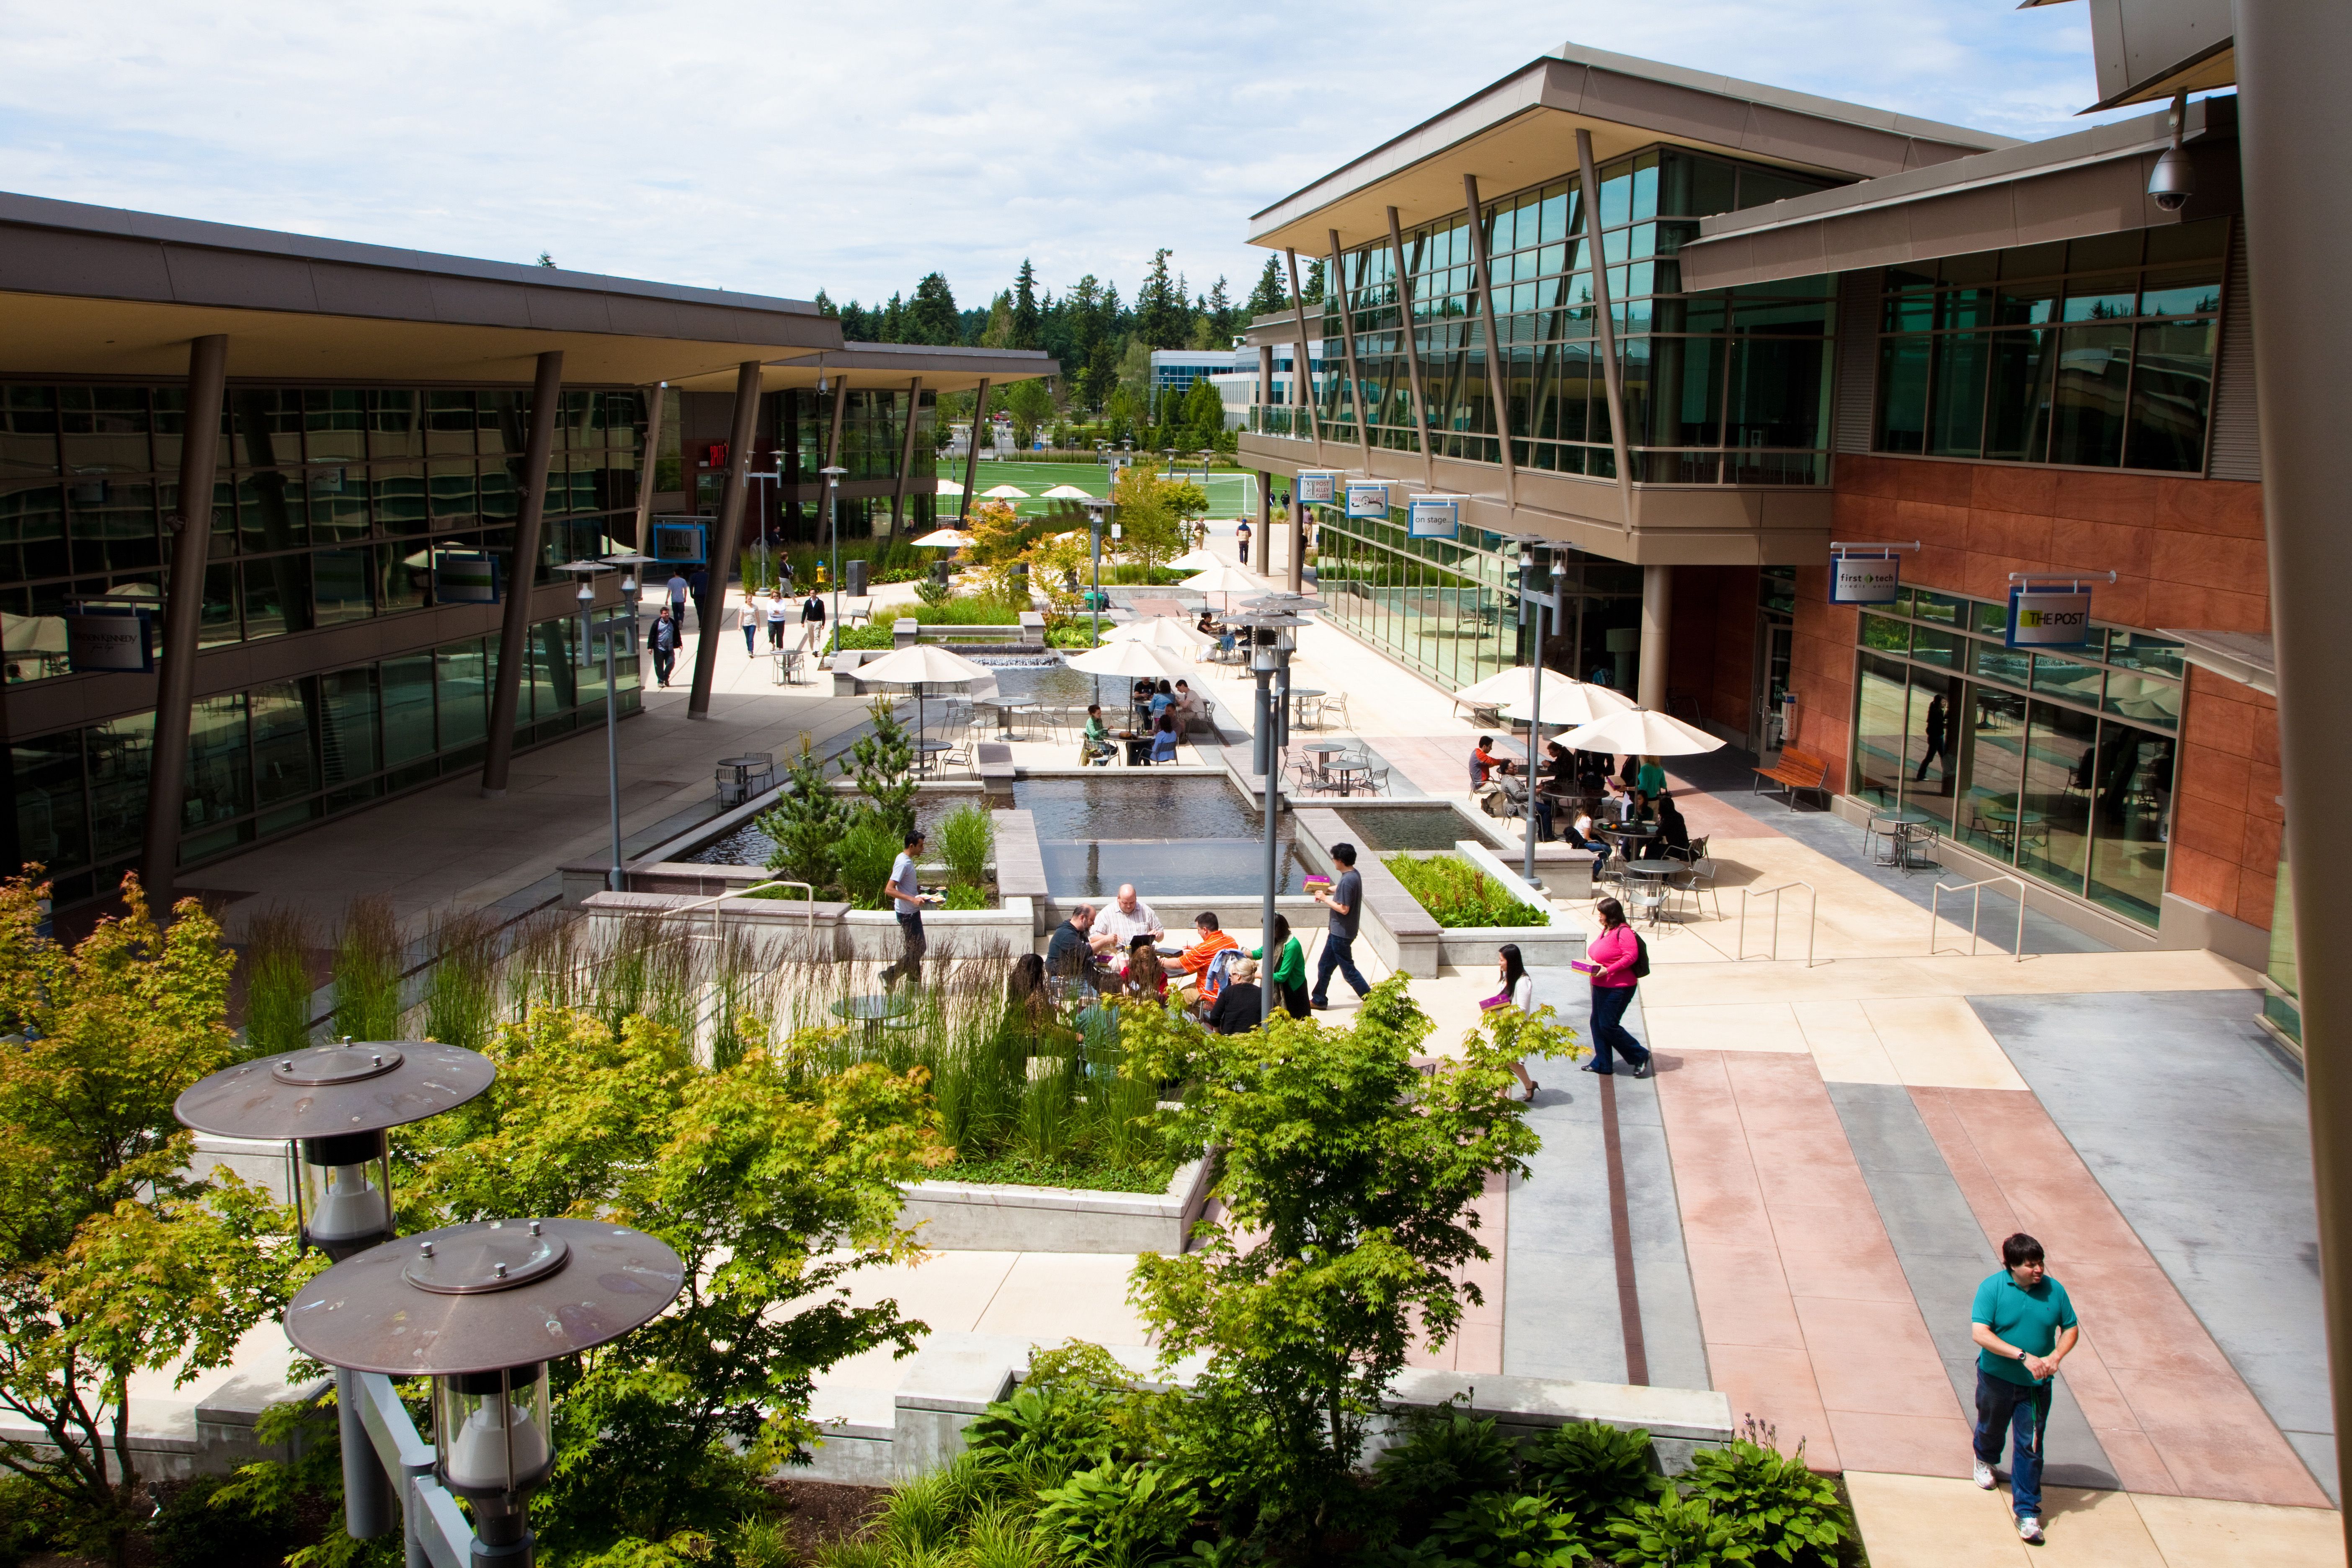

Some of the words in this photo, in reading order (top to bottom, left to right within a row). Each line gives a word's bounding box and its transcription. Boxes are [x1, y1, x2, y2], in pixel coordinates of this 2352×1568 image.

[665, 532, 691, 546] ACAPULCO
[2030, 613, 2053, 625] THE
[2055, 612, 2084, 625] POST
[101, 634, 137, 644] KENNEDY
